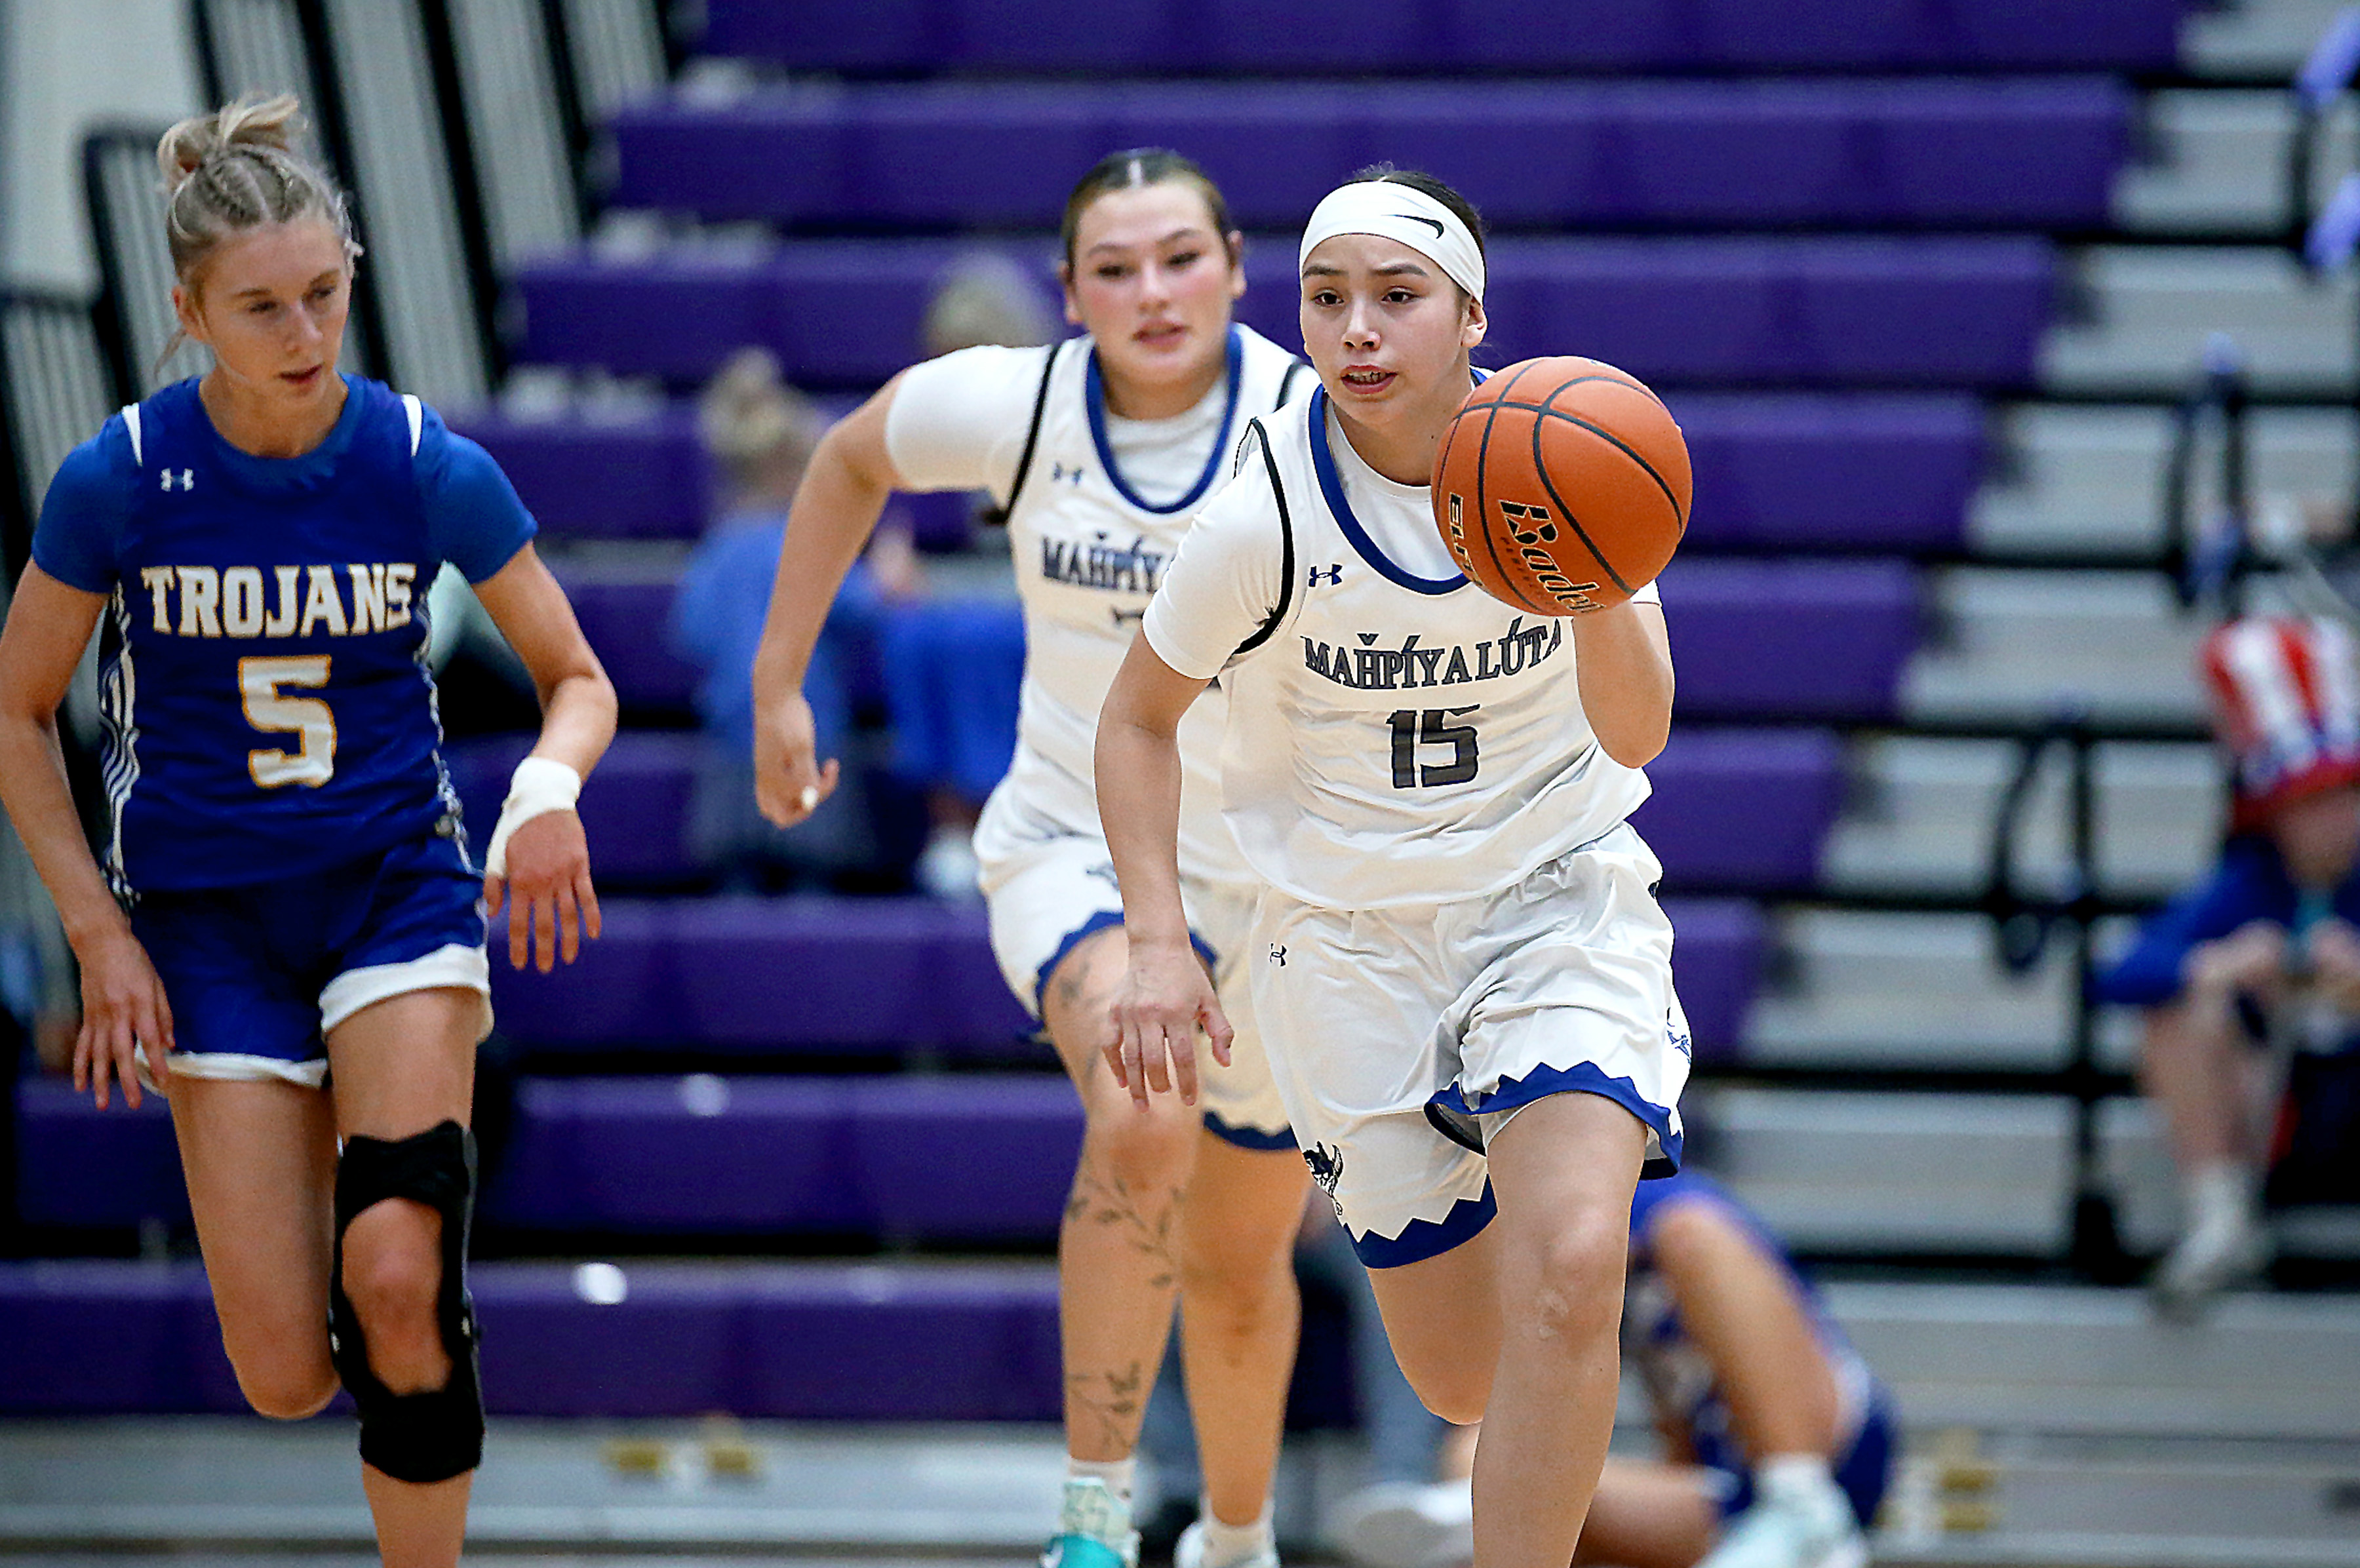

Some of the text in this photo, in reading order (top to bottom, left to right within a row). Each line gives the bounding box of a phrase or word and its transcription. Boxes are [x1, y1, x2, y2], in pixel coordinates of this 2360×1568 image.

[140, 562, 417, 638] TROJANS
[237, 654, 337, 789] 5
[1386, 703, 1481, 789] 15
